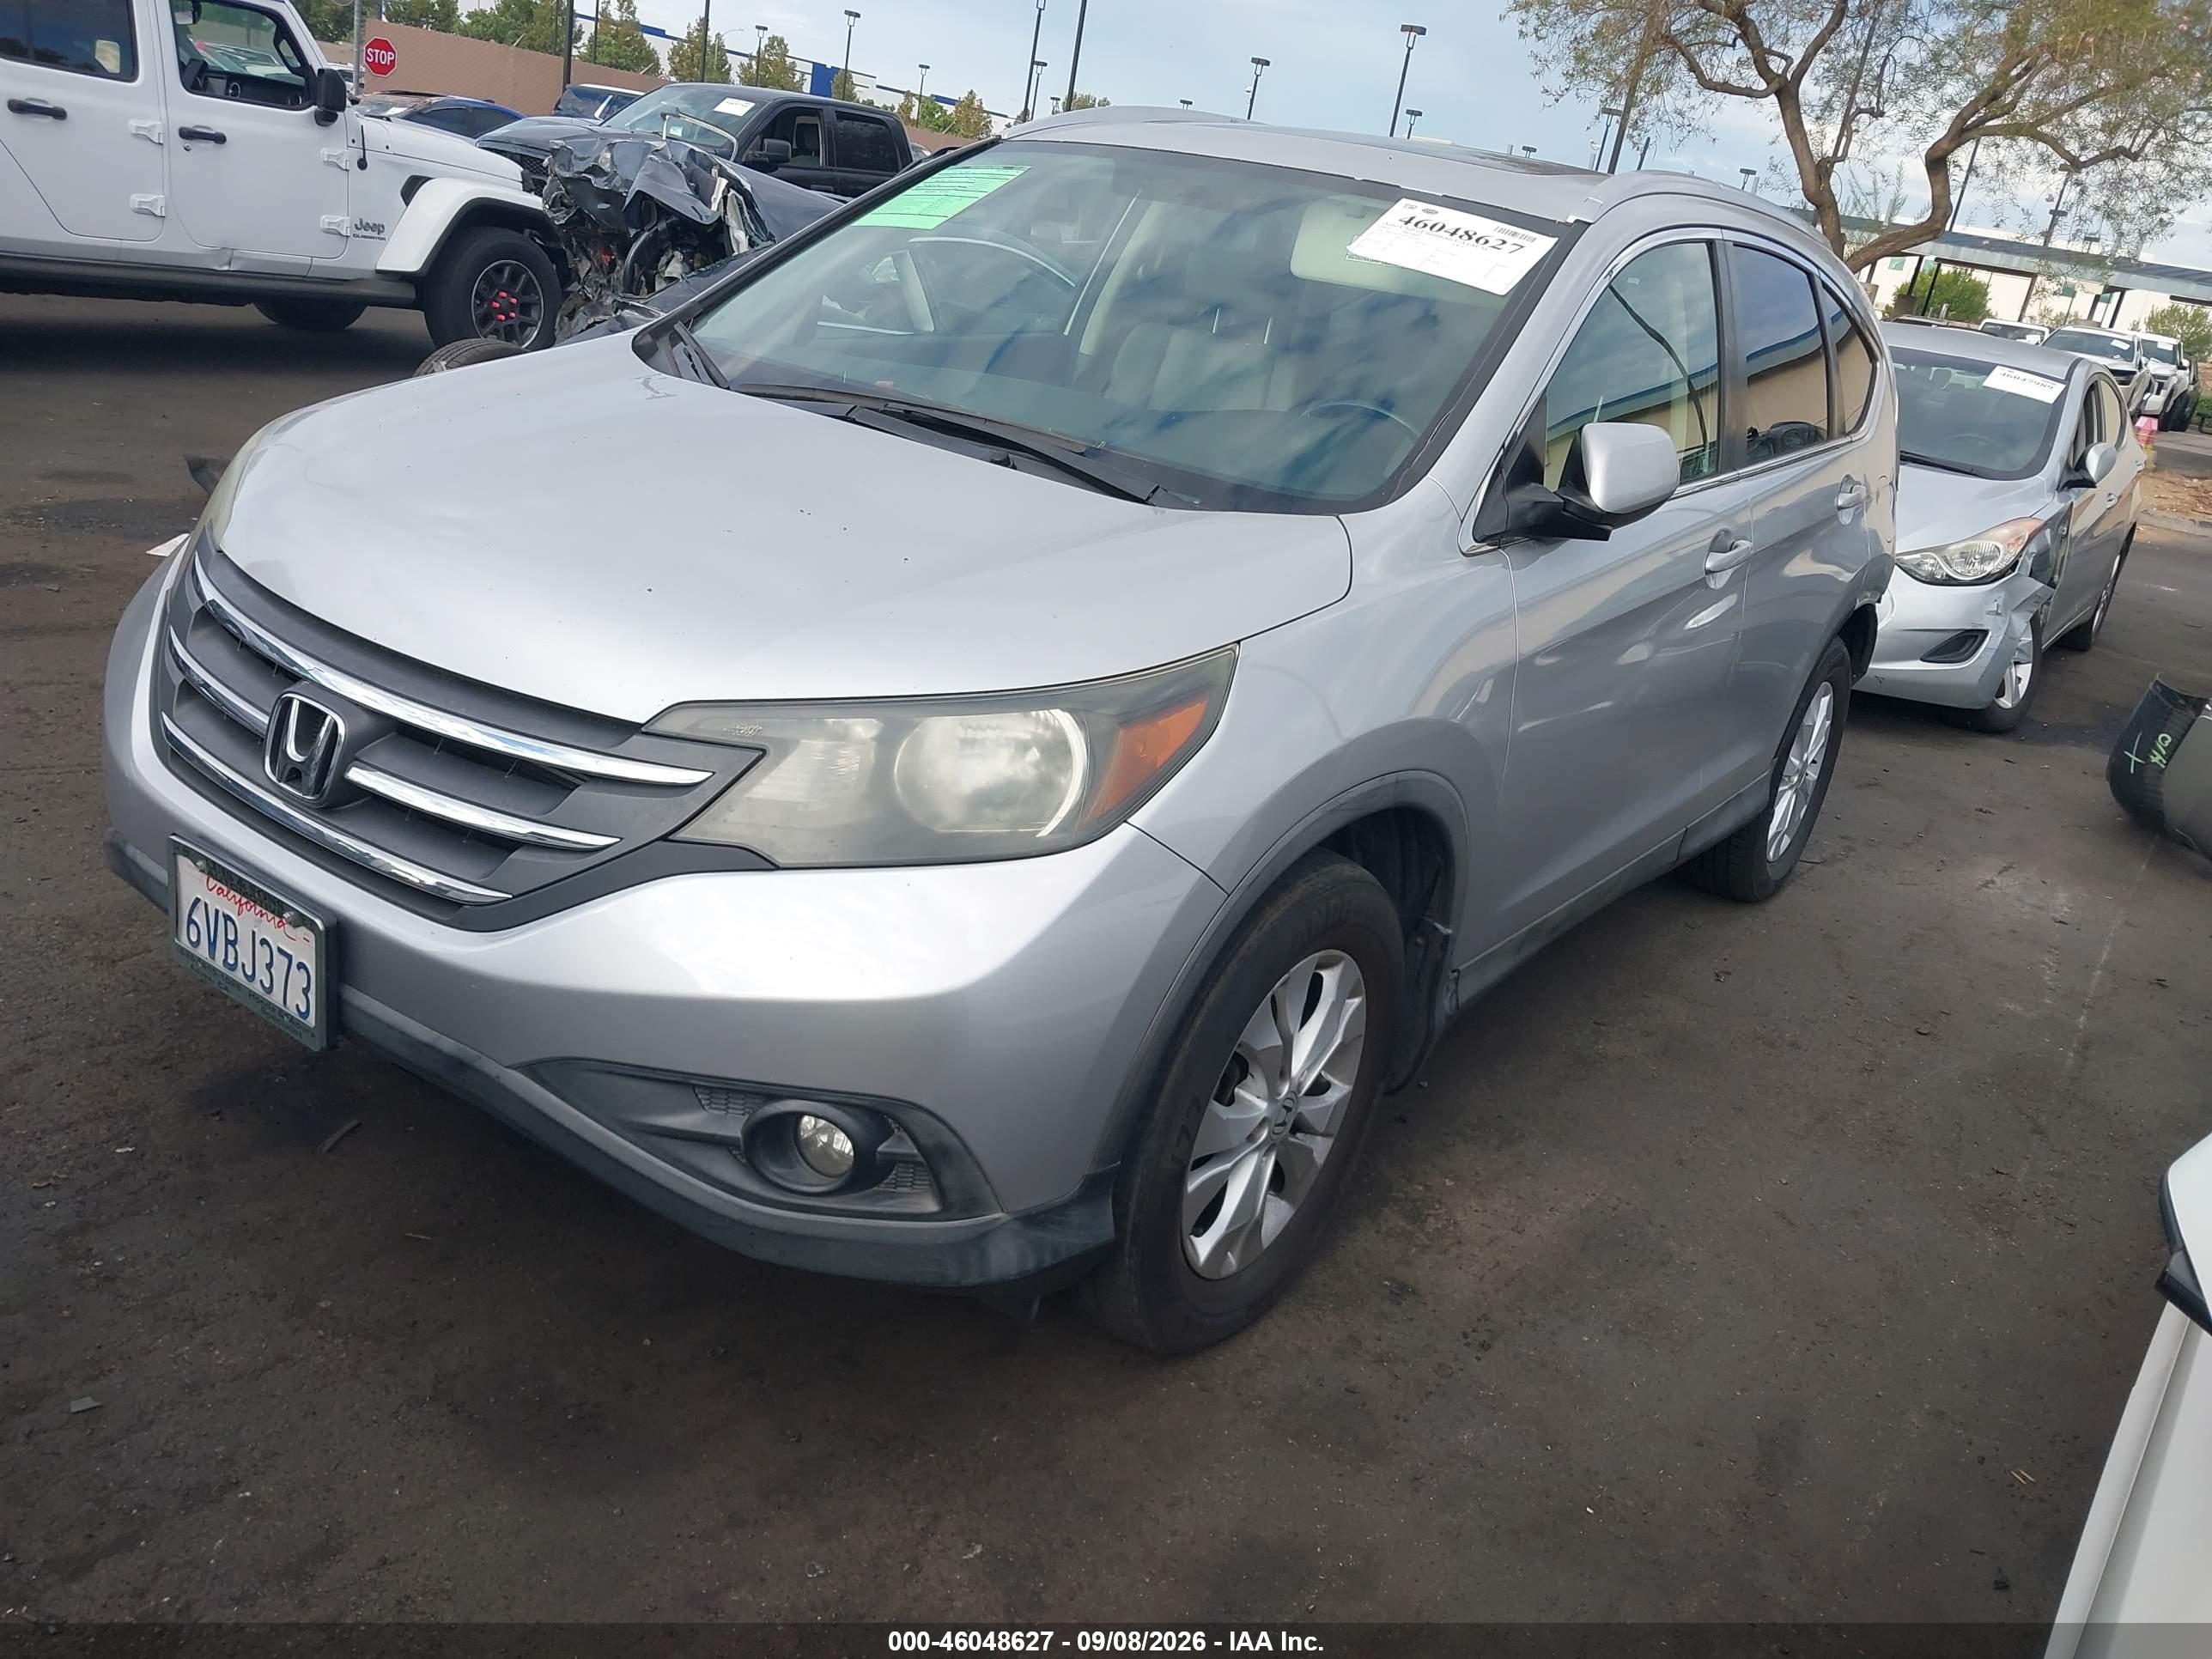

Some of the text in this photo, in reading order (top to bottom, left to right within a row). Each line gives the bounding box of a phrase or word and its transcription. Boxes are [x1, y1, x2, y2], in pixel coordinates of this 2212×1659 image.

[367, 48, 394, 65] STOP
[354, 218, 385, 235] Jeep
[1399, 216, 1526, 254] 46048627
[186, 896, 312, 1020] 6VBJ373
